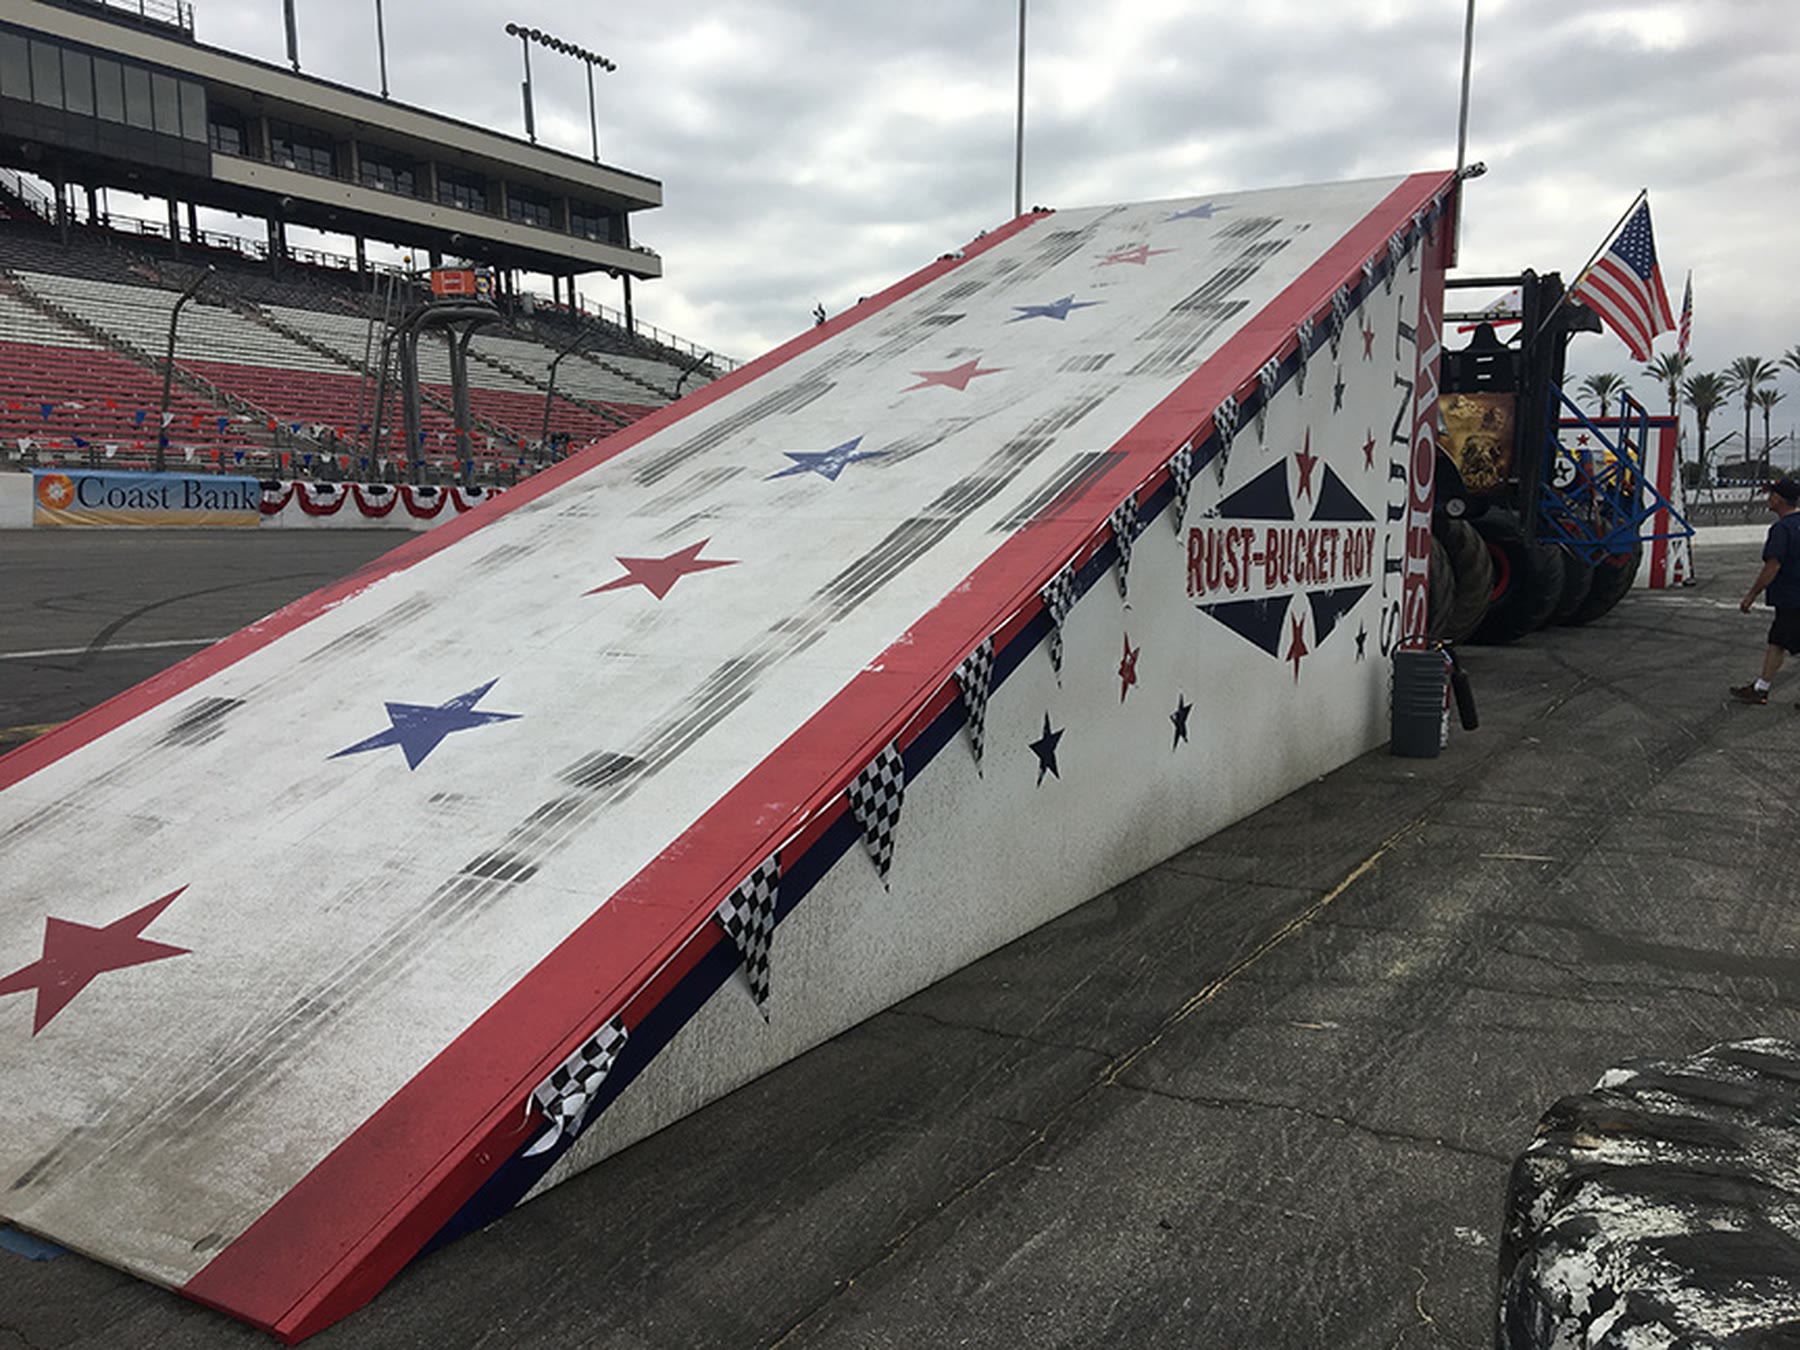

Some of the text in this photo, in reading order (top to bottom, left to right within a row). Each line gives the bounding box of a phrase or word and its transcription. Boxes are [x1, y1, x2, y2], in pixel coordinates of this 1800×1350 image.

[77, 476, 256, 510] Coast Bank
[1187, 526, 1376, 597] RUST-BUCKET ROY
[1381, 294, 1417, 656] STUNT
[1404, 298, 1441, 645] SHOW
